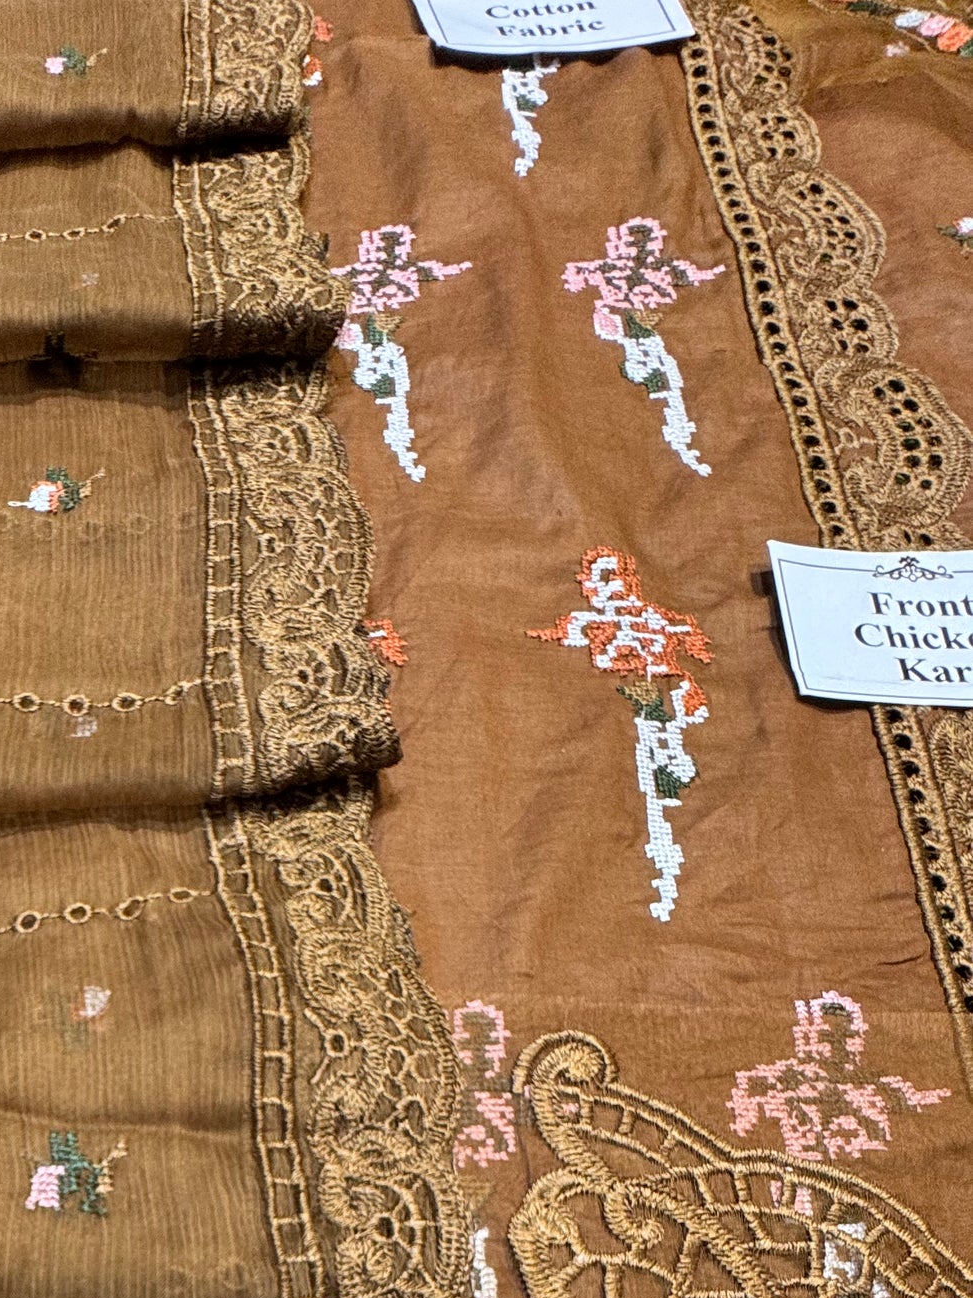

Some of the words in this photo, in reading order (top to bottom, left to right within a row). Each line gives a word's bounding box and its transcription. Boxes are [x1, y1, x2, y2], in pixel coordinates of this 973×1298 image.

[485, 0, 597, 19] Cotton
[496, 18, 606, 37] Fabric
[867, 591, 973, 617] Front
